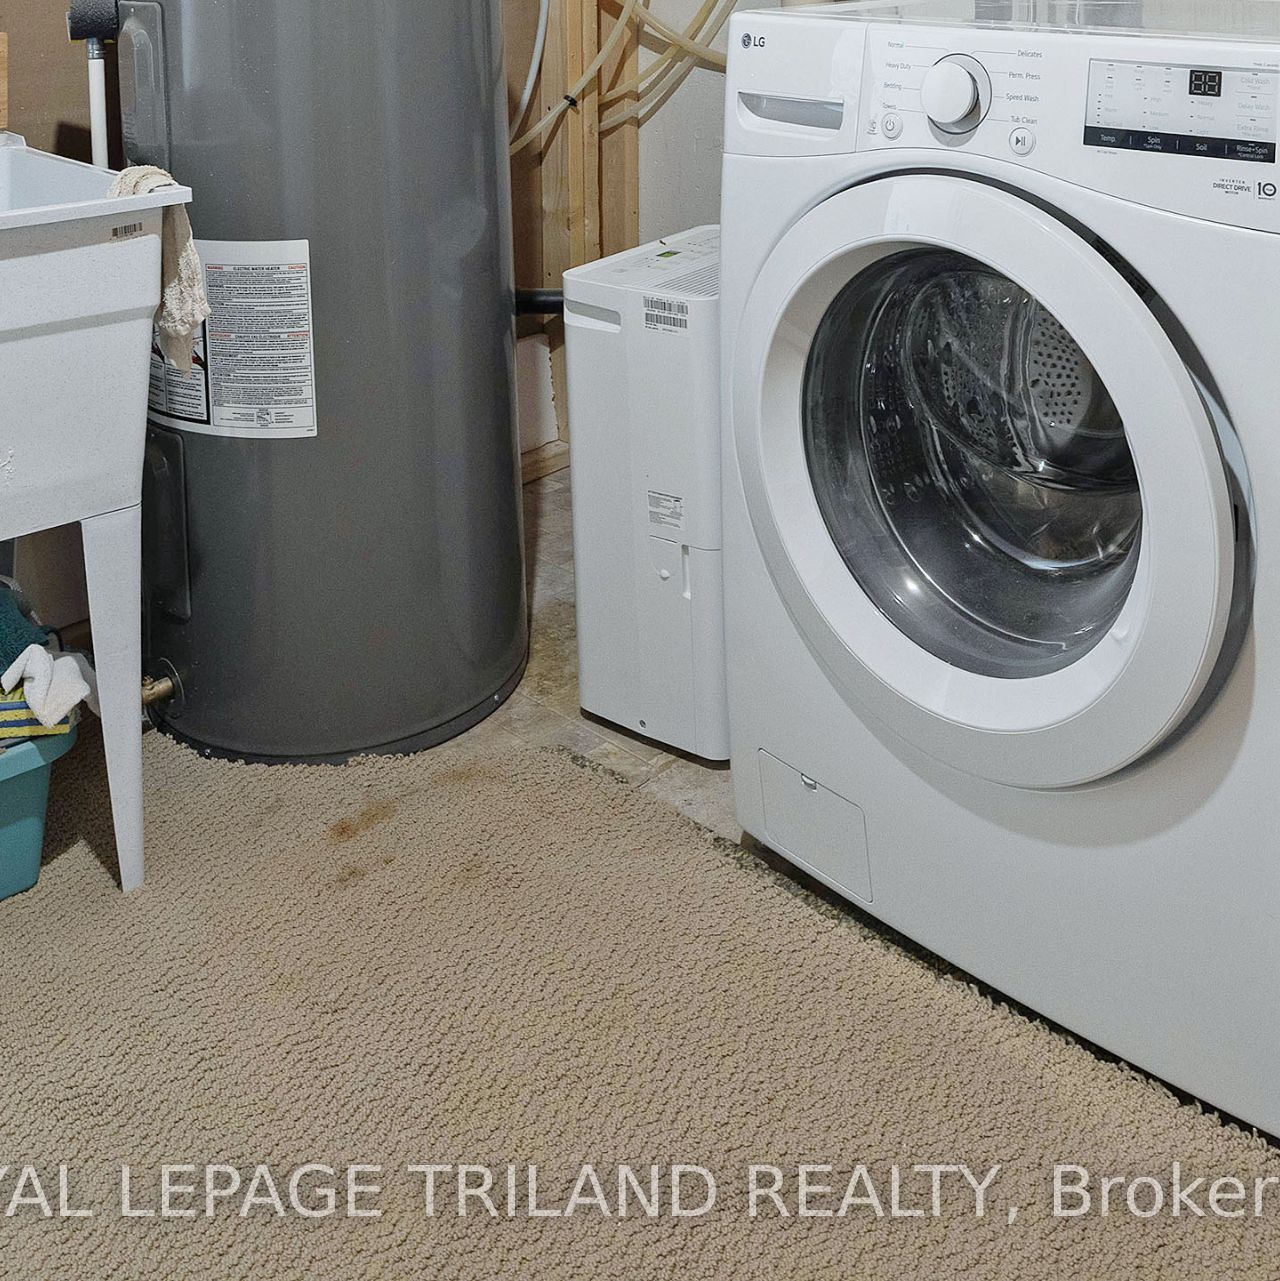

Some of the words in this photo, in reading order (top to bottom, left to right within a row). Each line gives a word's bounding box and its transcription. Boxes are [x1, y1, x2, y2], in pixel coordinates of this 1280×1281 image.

[753, 36, 766, 48] LG
[1017, 50, 1043, 59] Delicates
[1025, 72, 1041, 81] Press
[1006, 93, 1023, 102] Speed
[1023, 94, 1039, 102] Wash
[1010, 115, 1021, 123] Tub
[1022, 116, 1037, 125] Clean
[1147, 135, 1161, 144] Spin
[1195, 143, 1208, 151] Soil
[1212, 182, 1233, 190] DIRECT
[1233, 184, 1251, 193] DRIVE
